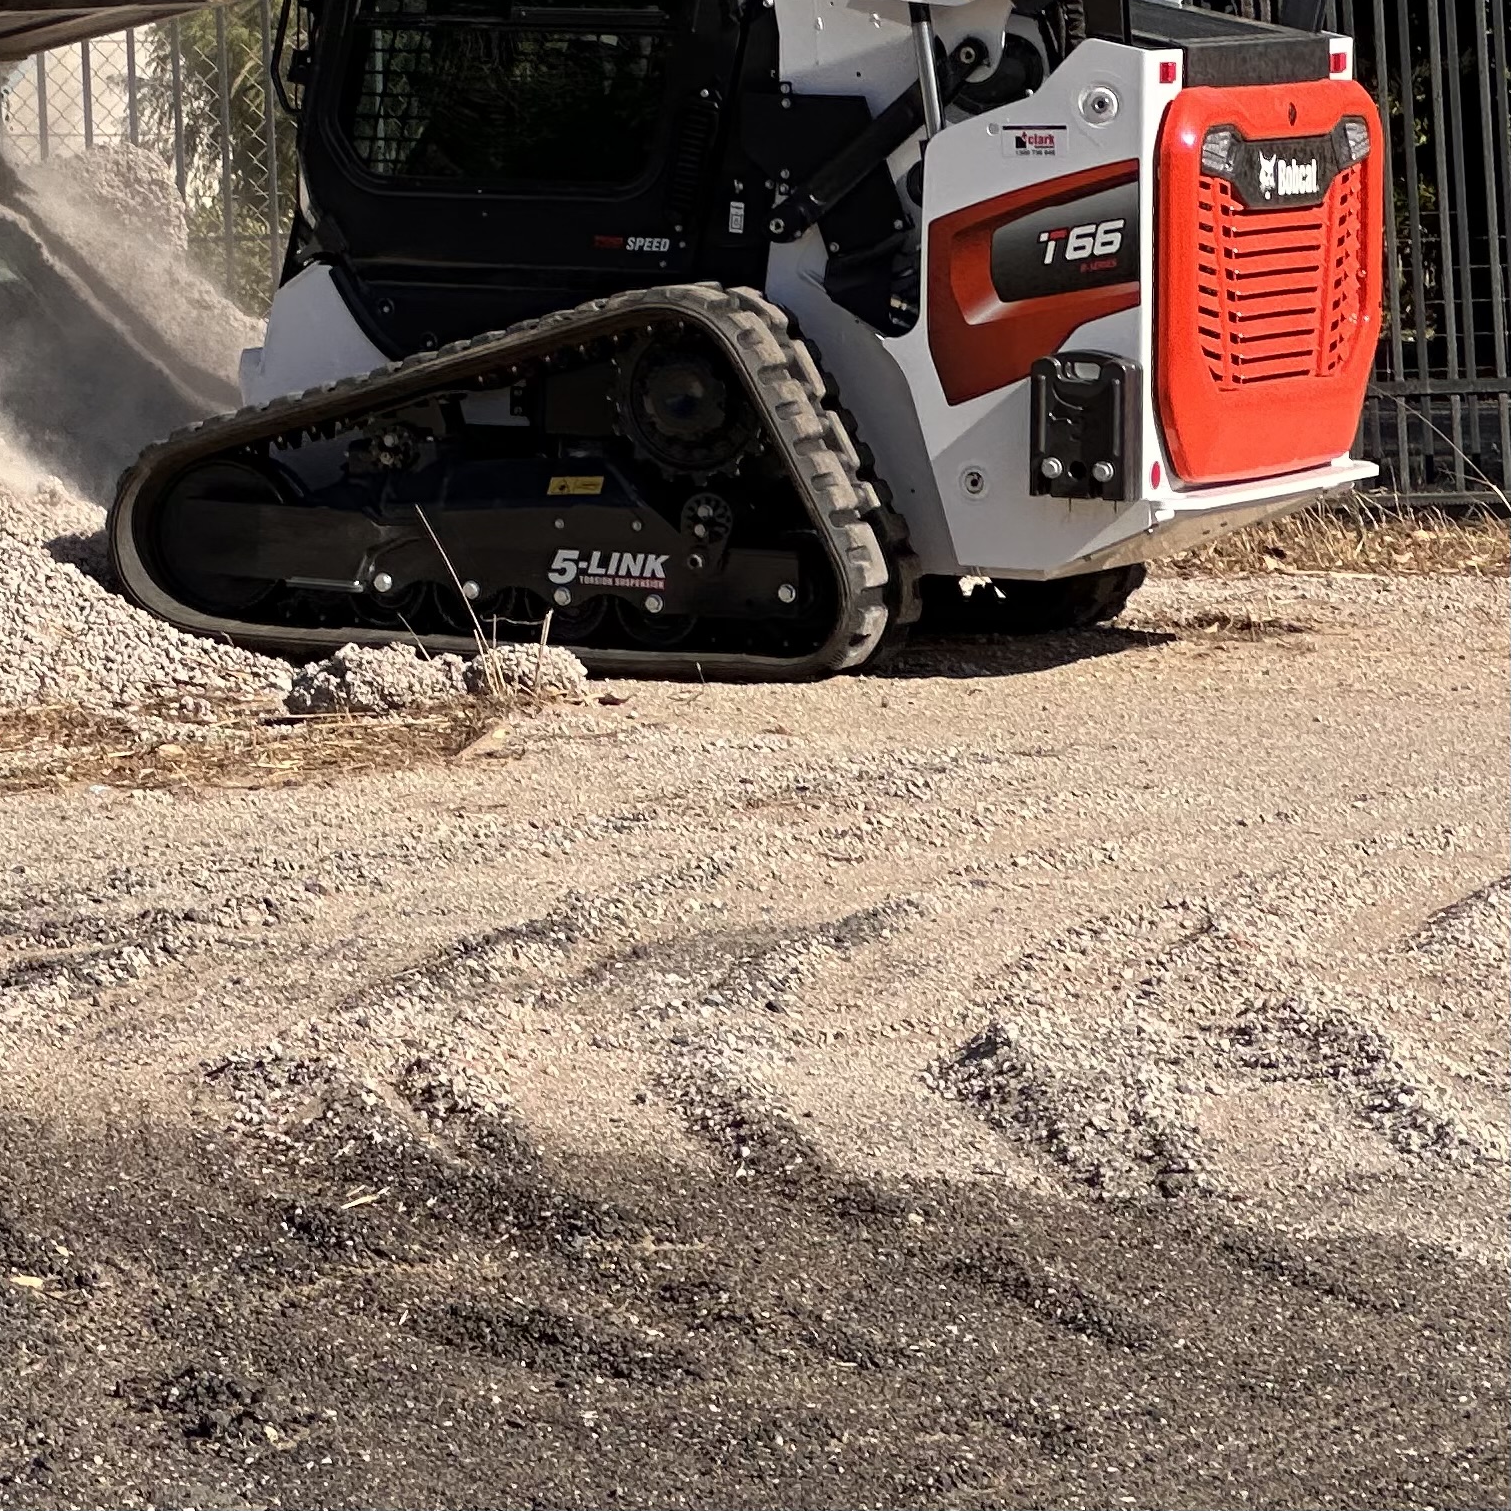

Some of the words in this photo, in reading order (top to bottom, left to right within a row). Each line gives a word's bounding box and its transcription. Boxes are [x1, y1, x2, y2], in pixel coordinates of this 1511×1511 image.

[1027, 134, 1054, 145] clark
[1277, 158, 1317, 196] Bobcat
[625, 236, 670, 251] SPEED
[1039, 219, 1124, 264] T66
[548, 549, 670, 584] 5-LINK
